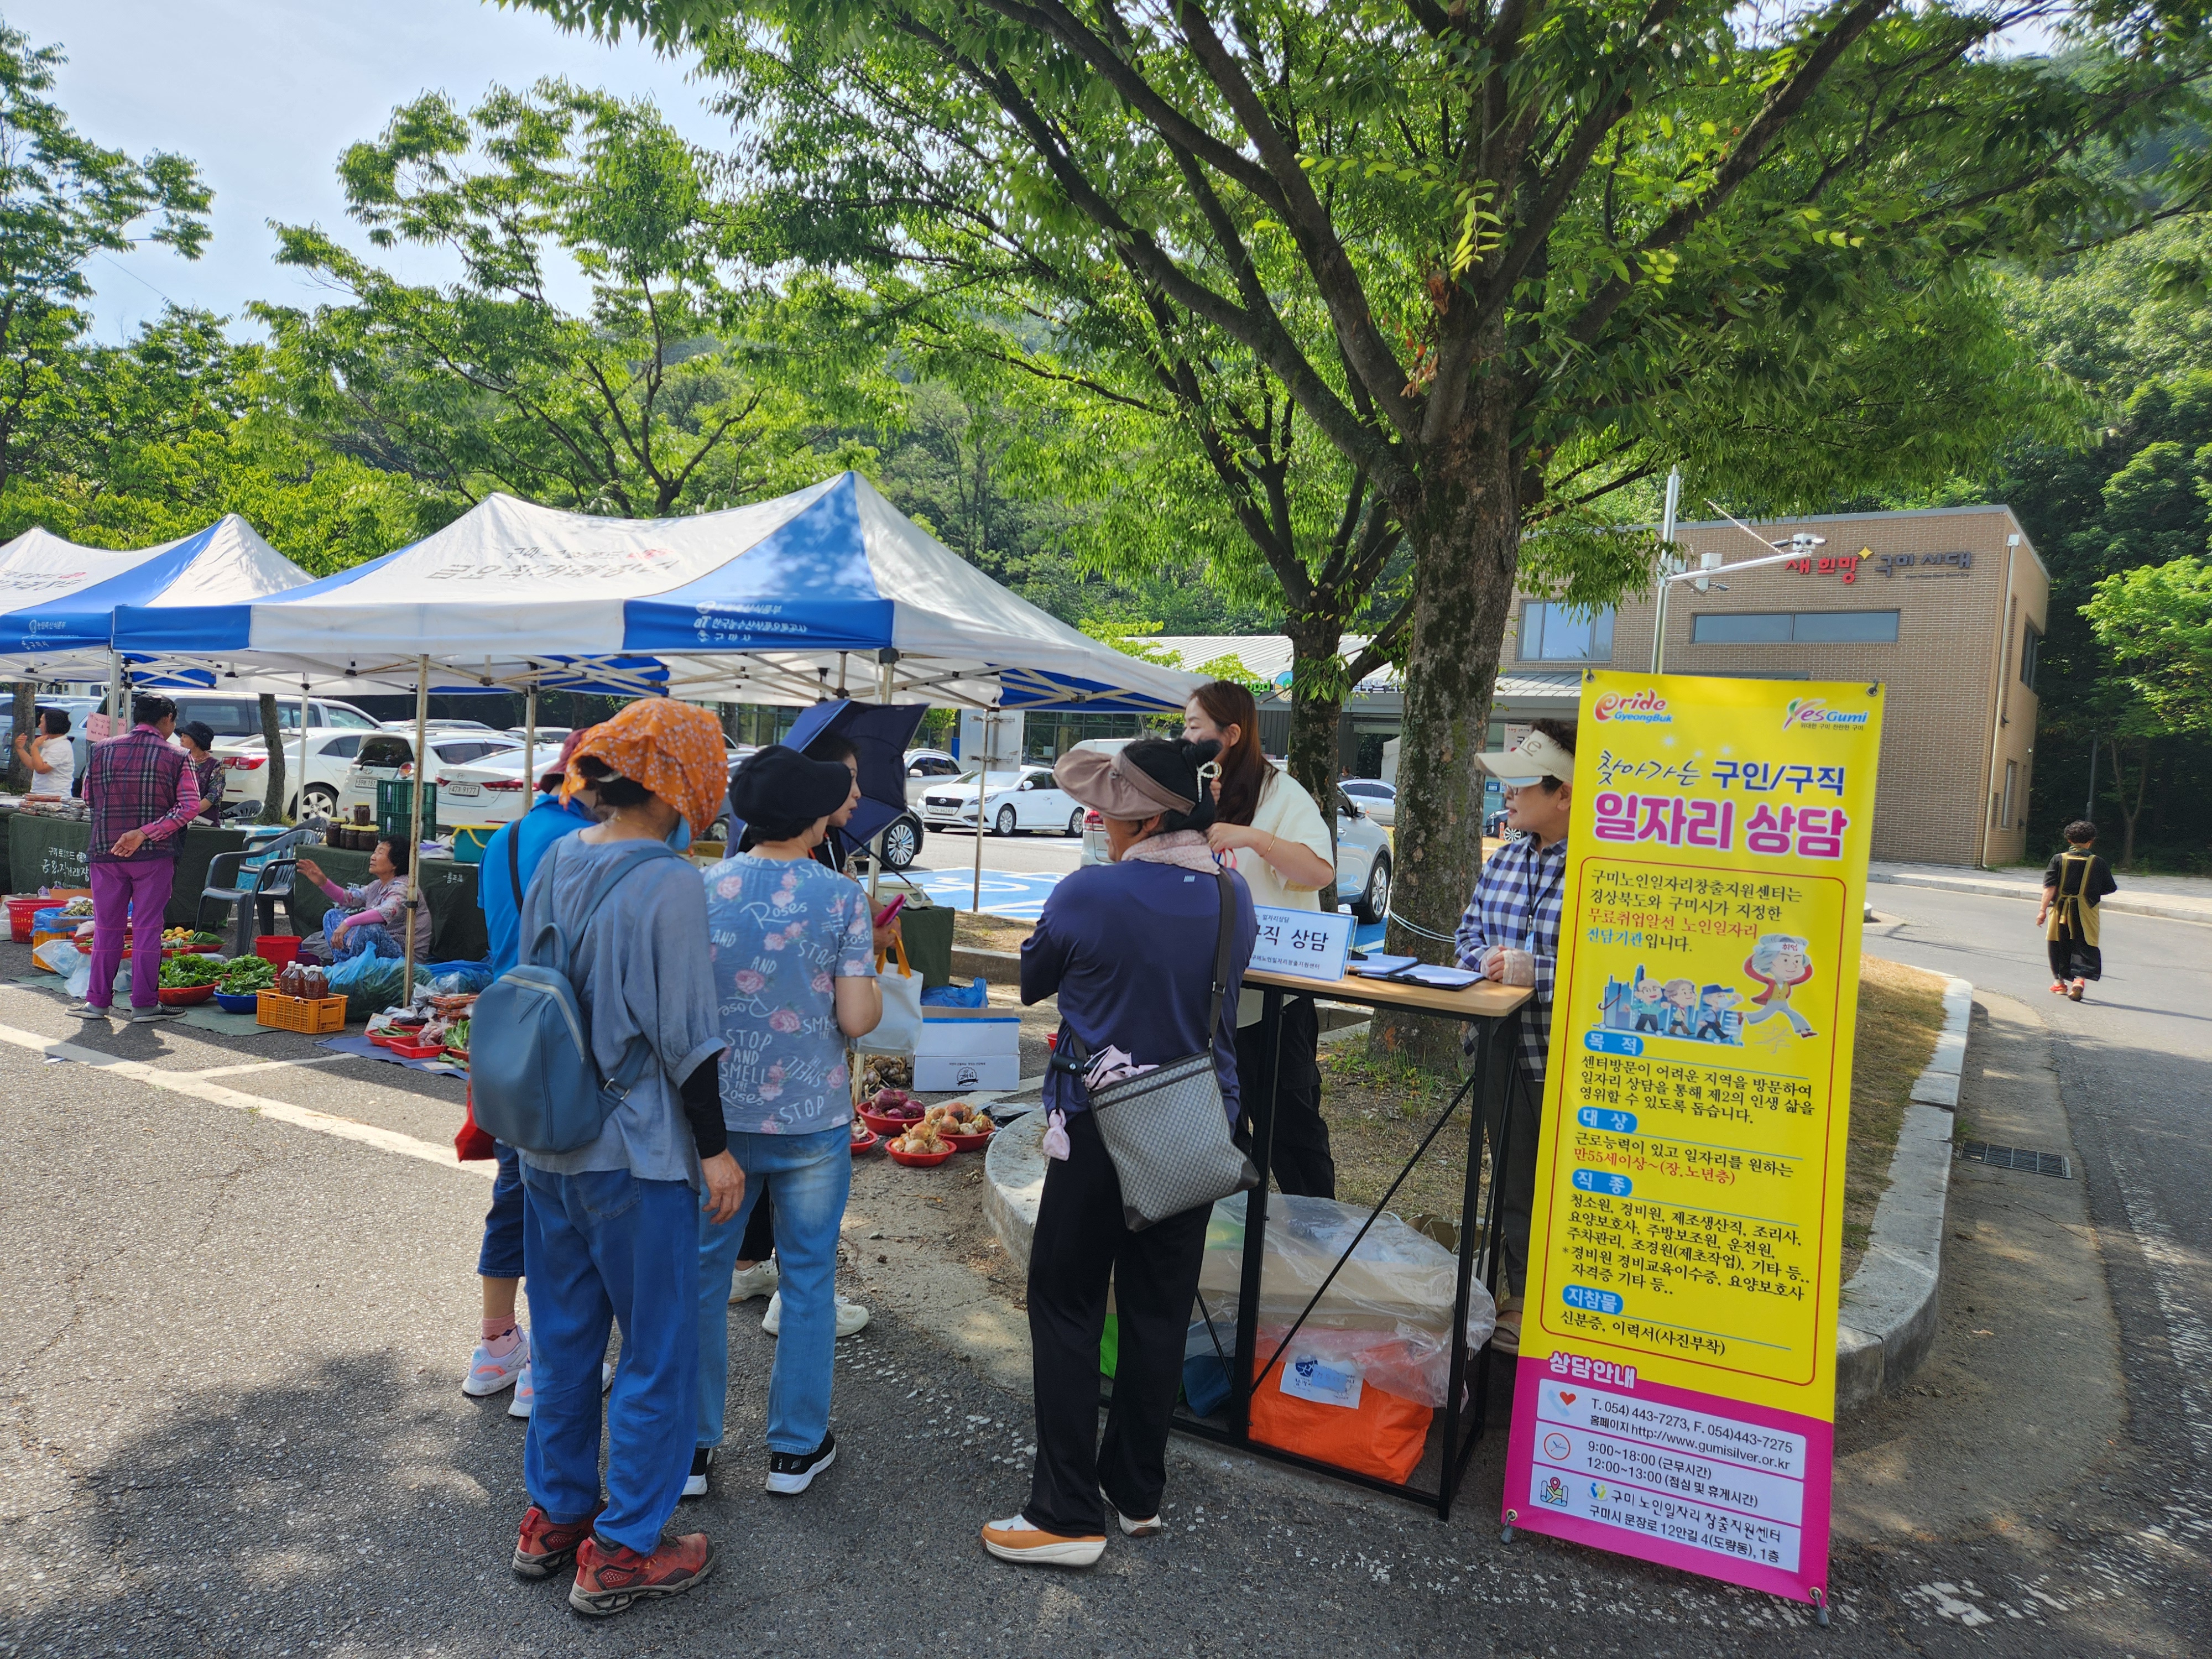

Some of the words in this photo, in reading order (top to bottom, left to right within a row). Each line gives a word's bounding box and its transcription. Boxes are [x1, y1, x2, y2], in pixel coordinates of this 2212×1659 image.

[1785, 558, 1811, 574] 새
[1818, 556, 1859, 584] 희망
[1875, 554, 1914, 578] 구미
[1920, 551, 1972, 568] 시대
[1614, 711, 1673, 724] GyeongBuk
[1783, 698, 1827, 729] Yes
[1826, 711, 1868, 723] Gumi
[1598, 750, 1700, 786] 찾아가는
[1712, 760, 1845, 796] 구인/구직
[1595, 794, 1734, 850] 일자리
[1746, 803, 1847, 858] 상담
[1591, 869, 1803, 903] 구미노인일자리창출지원센터는
[739, 901, 808, 930] Roses
[1262, 914, 1290, 924] 일자리상담
[1590, 889, 1661, 910] 경상북도와
[1669, 896, 1729, 916] 구미시가
[1736, 904, 1782, 922] 지정한
[712, 929, 737, 948] AND
[1291, 929, 1329, 952] 상담
[1586, 927, 1693, 952] 전담기관입니다.
[1588, 907, 1675, 931] 무료취업알선
[1682, 918, 1758, 940] 노인일자리
[798, 940, 837, 969] STOP
[1782, 943, 1798, 952] 취업
[750, 956, 777, 974] AND
[726, 1029, 773, 1052] STOP
[733, 1048, 759, 1066] AND
[721, 1062, 765, 1084] SMELL
[1582, 1056, 1651, 1077] 센터방문이
[1657, 1066, 1699, 1083] 어려운
[1705, 1072, 1748, 1090] 지역을
[1752, 1078, 1813, 1099] 방문하여
[779, 1095, 825, 1124] STOP
[1580, 1086, 1621, 1104] 영위할
[1625, 1094, 1640, 1107] 수
[1645, 1095, 1687, 1114] 있도록
[1691, 1102, 1754, 1124] 돕습니다.
[1582, 1071, 1621, 1088] 일자리
[1626, 1077, 1670, 1095] 상담을
[1676, 1084, 1702, 1100] 통해
[1708, 1088, 1744, 1106] 제2의
[1750, 1094, 1779, 1111] 인생
[1784, 1099, 1815, 1116] 삶을
[1574, 1131, 1645, 1156] 근로능력이
[1651, 1143, 1679, 1159] 있고
[1685, 1148, 1743, 1171] 일자리를
[1748, 1157, 1794, 1178] 원하는
[1574, 1147, 1736, 1186] 만55세이상~(장.노년층)
[1568, 1211, 1640, 1236] 요양보호사,
[1646, 1223, 1721, 1249] 주방보조원,
[1726, 1238, 1775, 1260] 운전원,
[1570, 1193, 1614, 1214] 청소원,
[1620, 1202, 1665, 1223] 경비원,
[1671, 1211, 1746, 1237] 제조생산직,
[1752, 1225, 1801, 1247] 조리사,
[1567, 1227, 1625, 1250] 주차관리,
[1631, 1239, 1745, 1272] 조경원(제초작업),
[1751, 1258, 1782, 1277] 기타
[1785, 1265, 1809, 1284] 등..
[1571, 1245, 1613, 1266] 경비원
[1618, 1254, 1721, 1287] 경비교육이수증,
[1727, 1275, 1804, 1302] 요양보호사
[1571, 1263, 1614, 1283] 자격증
[1618, 1270, 1646, 1289] 기타
[1650, 1276, 1673, 1296] 등..
[1567, 1287, 1618, 1313] 지참물
[1561, 1311, 1605, 1333] 신분증,
[1612, 1321, 1726, 1357] 이력서(사진부착)
[1550, 1352, 1635, 1389] 상담안내
[1590, 1415, 1629, 1433] 홈페이지
[1631, 1423, 1791, 1470] http://www.gumisilver.or.kr
[1591, 1397, 1602, 1411] T.
[1604, 1401, 1630, 1417] 054)
[1631, 1407, 1691, 1432] 443-7273,
[1694, 1421, 1705, 1434] F.
[1708, 1424, 1793, 1454] 054)443-7275
[1588, 1441, 1656, 1466] 9:00~18:00
[1658, 1456, 1712, 1481] (근무시간)
[1587, 1457, 1662, 1484] 12:00~13:00
[1664, 1475, 1691, 1492] (점심
[1694, 1482, 1704, 1495] 및
[1708, 1485, 1758, 1508] 휴게시간)
[1611, 1489, 1635, 1507] 구미
[1639, 1496, 1700, 1523] 노인일자리
[1704, 1512, 1781, 1544] 창출지원센터
[1589, 1505, 1622, 1522] 구미시
[1624, 1513, 1658, 1532] 문장로
[1661, 1523, 1698, 1543] 12안길
[1700, 1533, 1757, 1559] 4(도량동),
[1760, 1547, 1780, 1564] 1층
